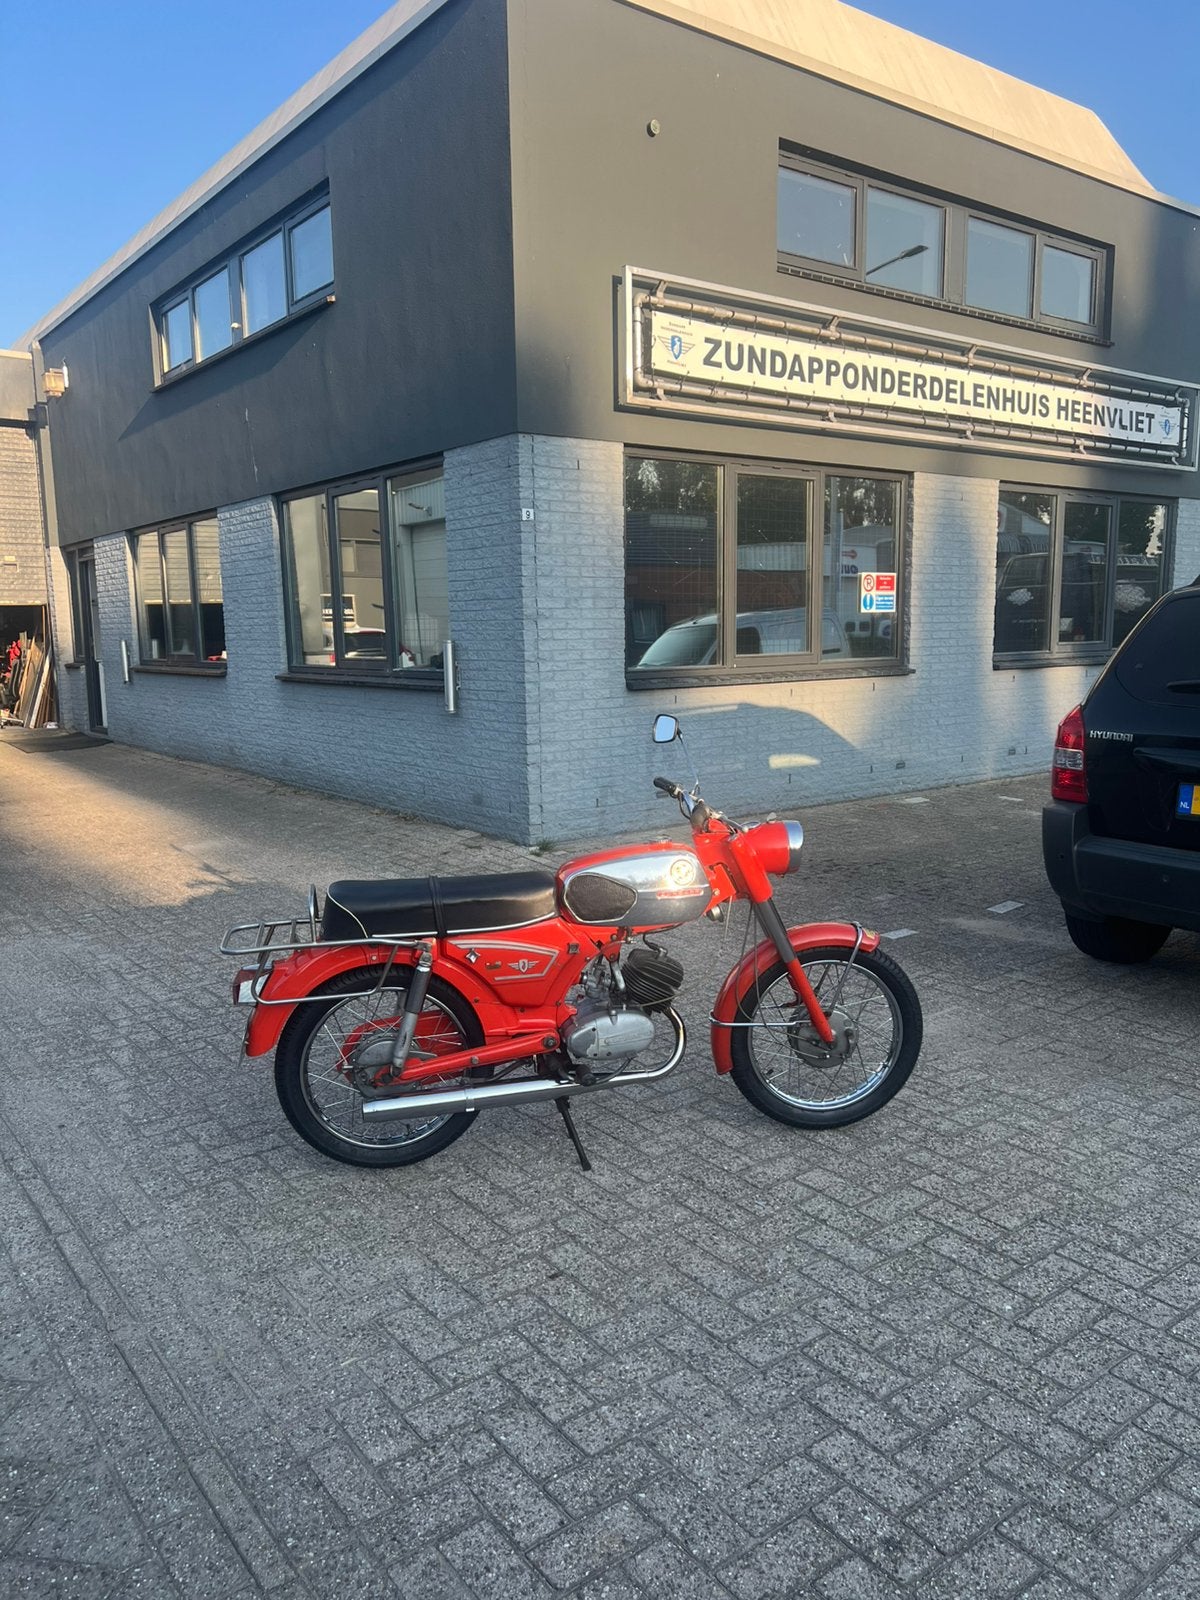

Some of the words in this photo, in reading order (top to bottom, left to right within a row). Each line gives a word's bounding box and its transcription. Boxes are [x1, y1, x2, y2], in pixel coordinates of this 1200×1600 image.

[703, 337, 1050, 418] ZUNDAPPONDERDELENHUIS
[1057, 398, 1155, 434] HEENVLIET
[1089, 730, 1134, 742] HYUNDAI
[1179, 801, 1190, 809] NL
